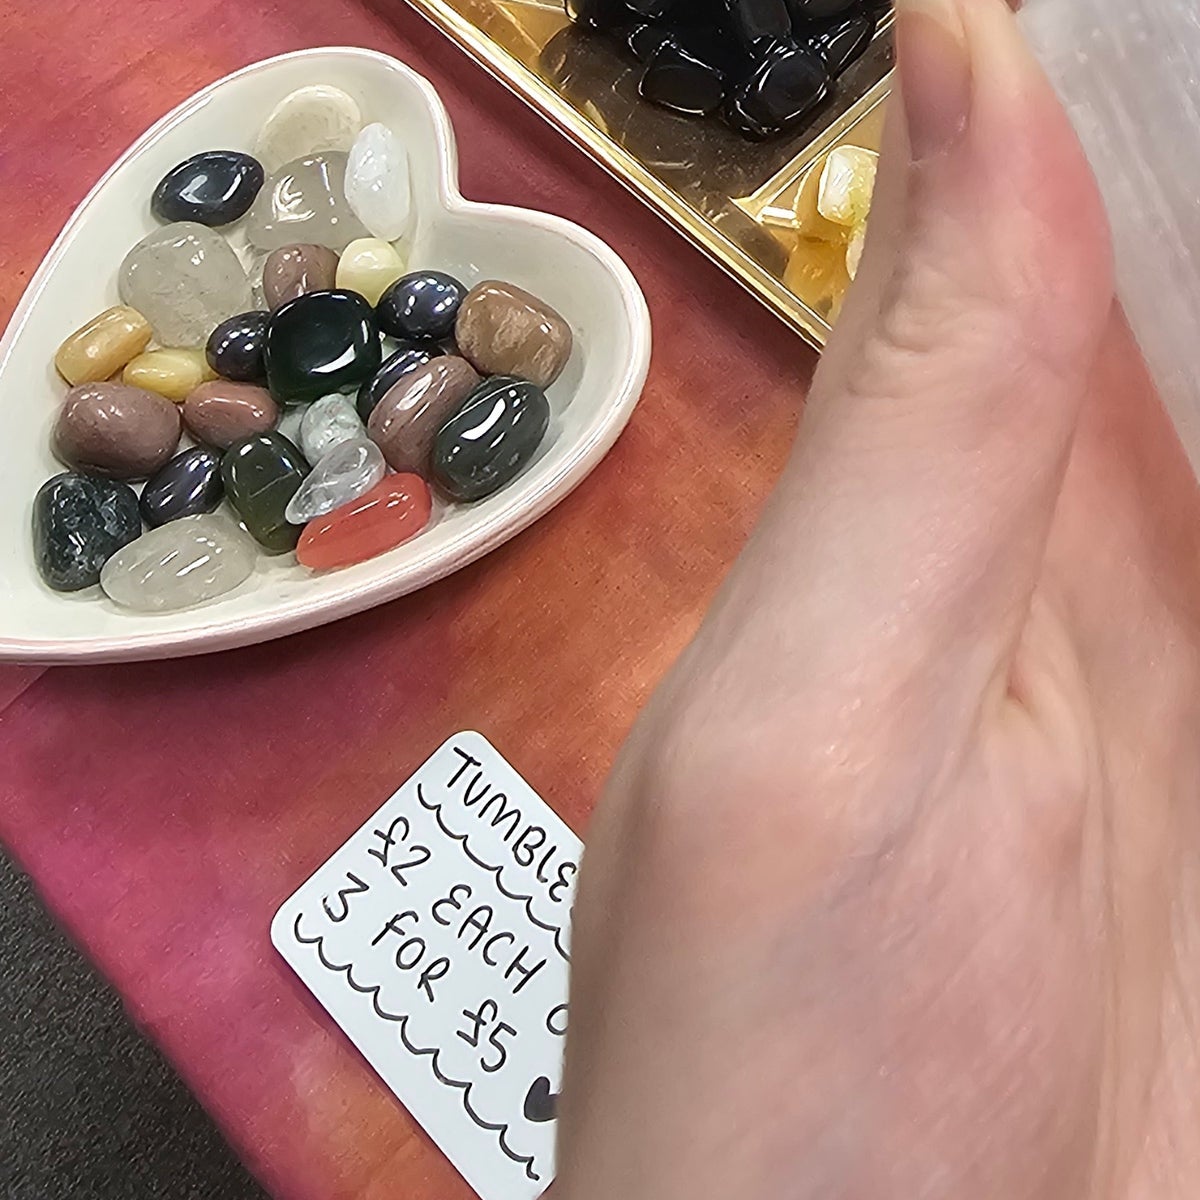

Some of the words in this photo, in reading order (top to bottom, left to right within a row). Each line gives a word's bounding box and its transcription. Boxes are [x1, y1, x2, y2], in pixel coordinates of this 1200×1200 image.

[367, 816, 432, 888] £2
[431, 884, 547, 995] EACH
[445, 746, 578, 925] TUMBLE
[321, 872, 370, 923] 3
[371, 910, 451, 1002] FOR
[456, 998, 518, 1074] £5
